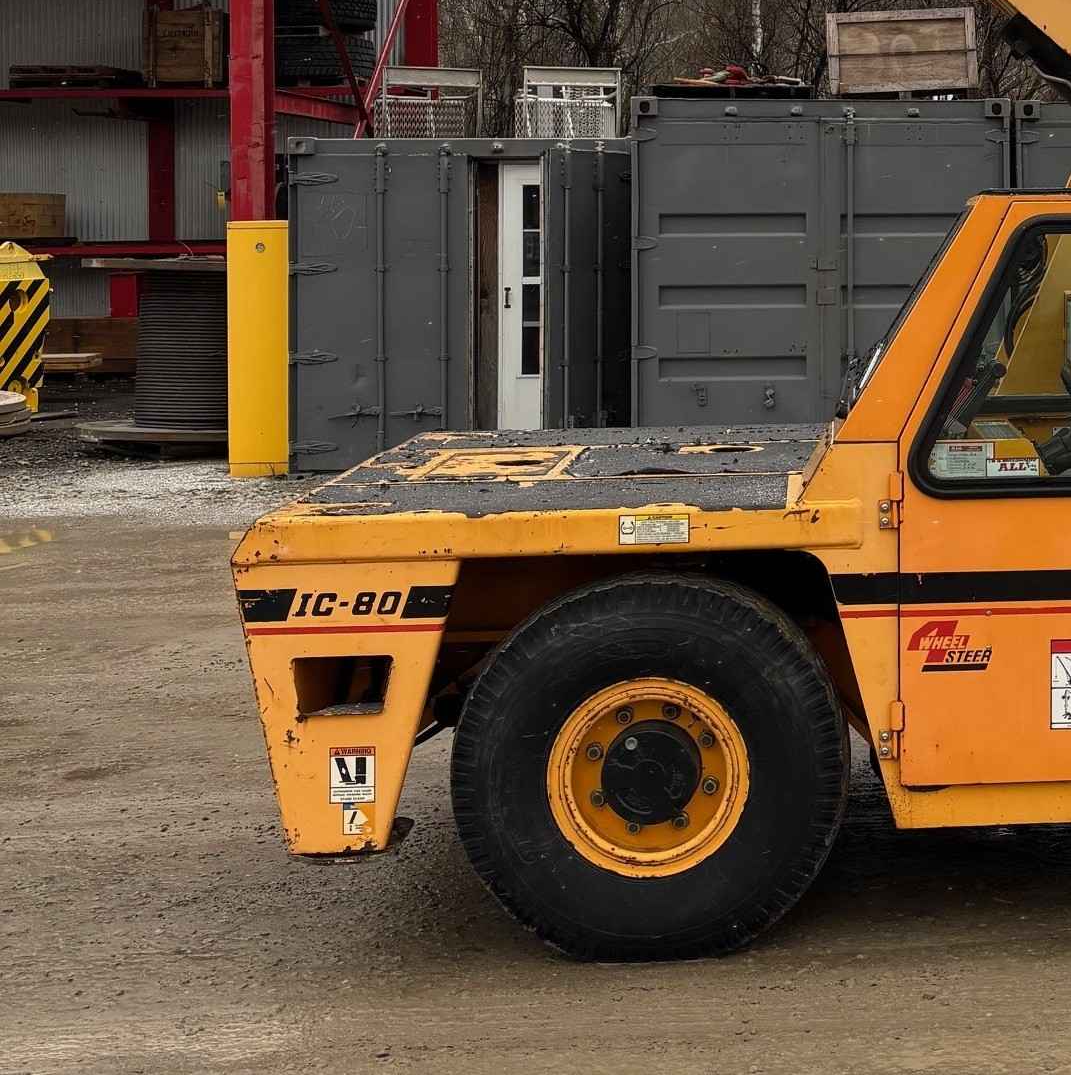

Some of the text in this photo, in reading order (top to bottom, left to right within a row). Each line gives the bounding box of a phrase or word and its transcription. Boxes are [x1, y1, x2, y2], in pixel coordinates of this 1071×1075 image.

[294, 591, 402, 616] IC-80
[907, 620, 959, 663] 4
[918, 635, 966, 650] WHEEL
[945, 649, 992, 663] STEER
